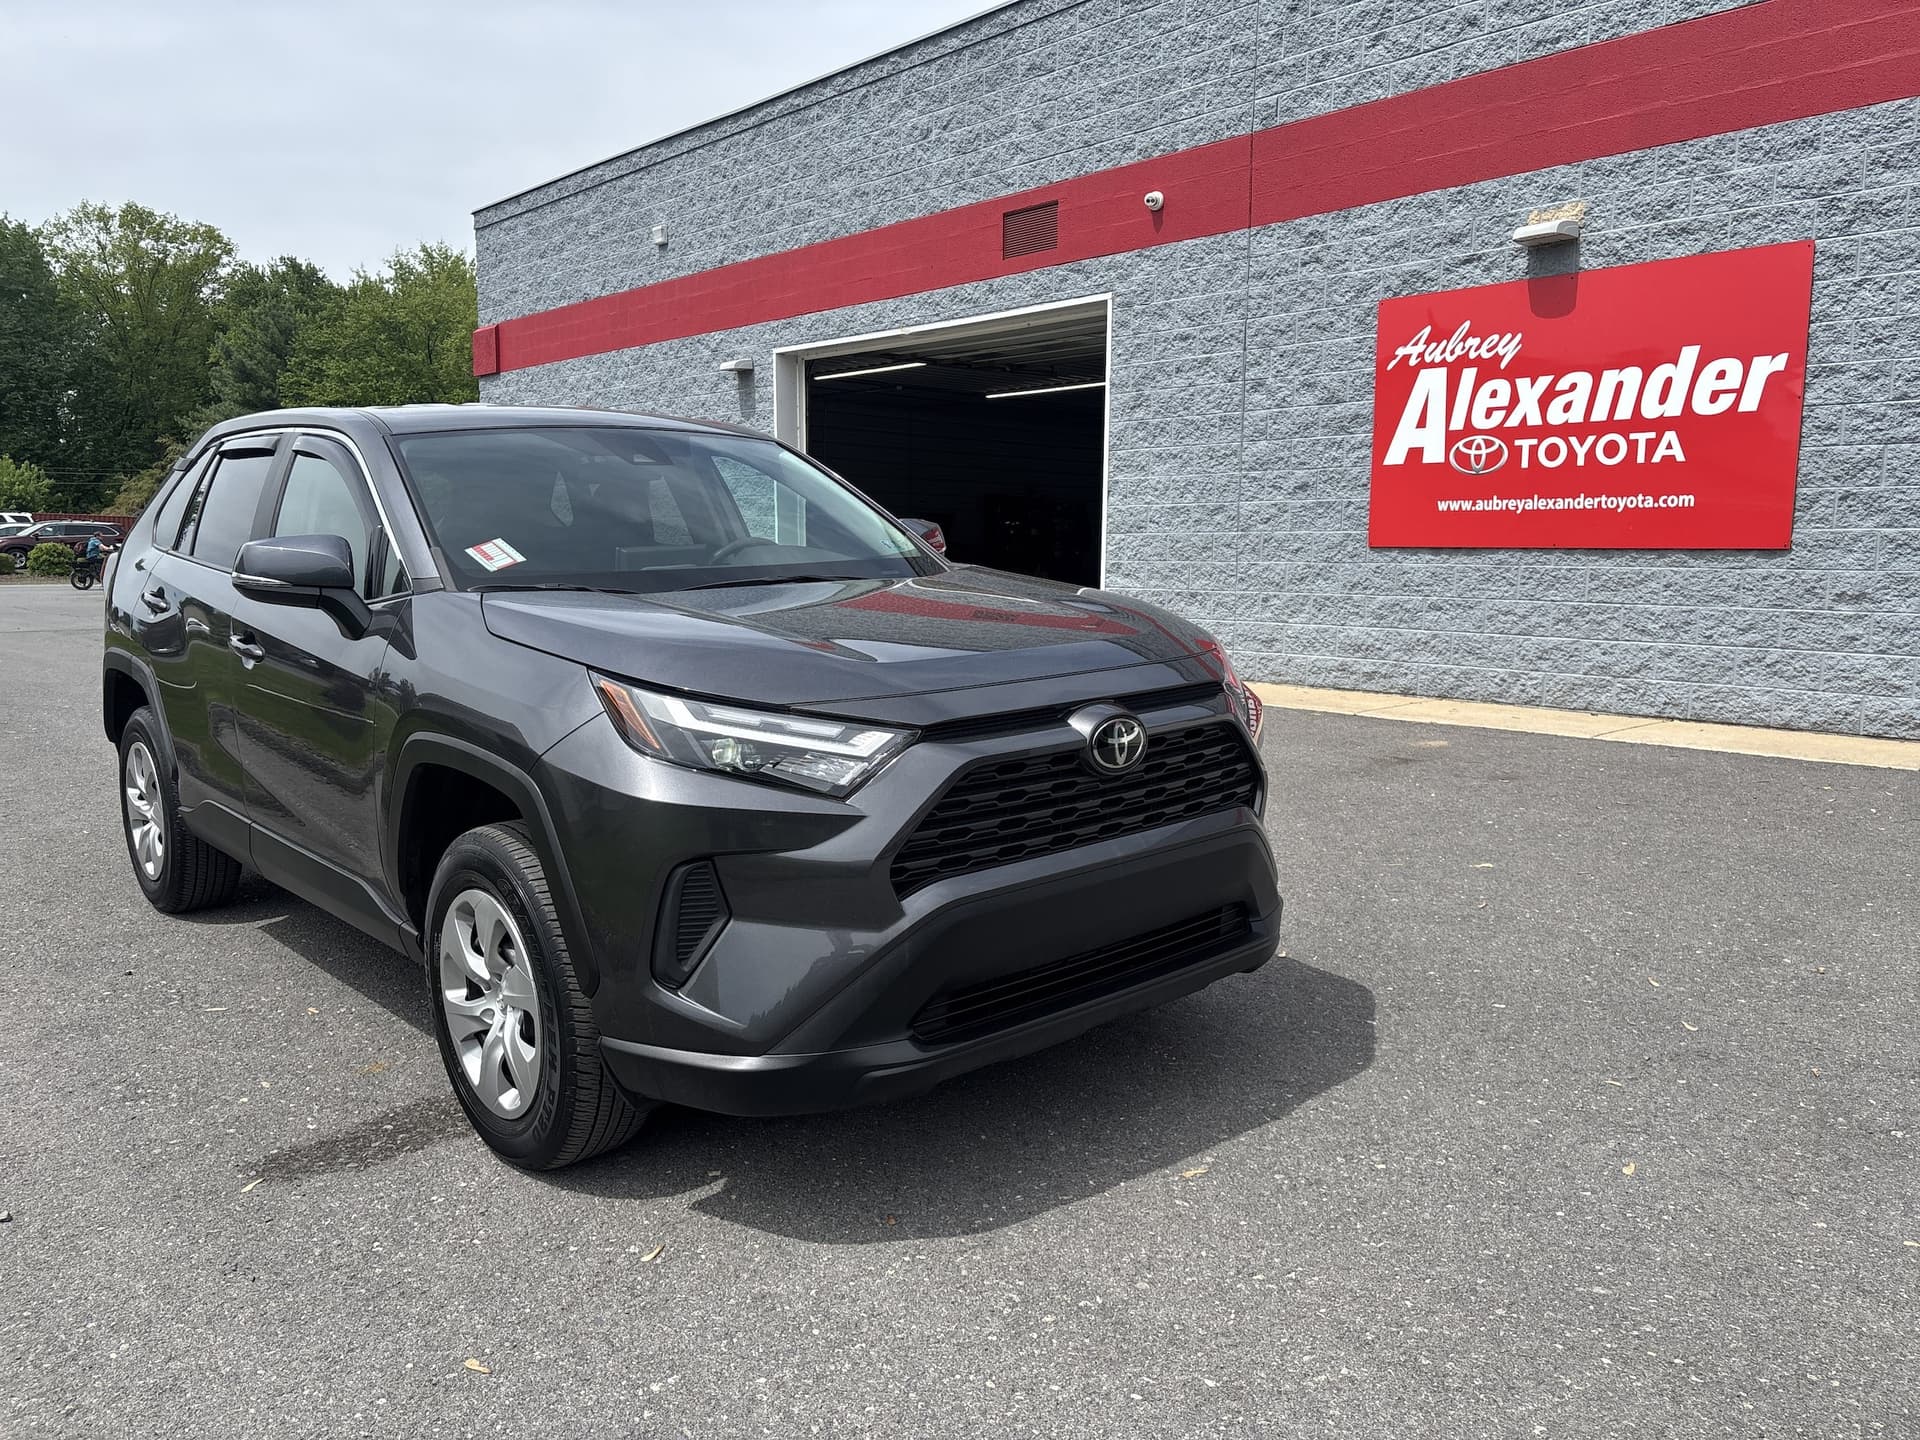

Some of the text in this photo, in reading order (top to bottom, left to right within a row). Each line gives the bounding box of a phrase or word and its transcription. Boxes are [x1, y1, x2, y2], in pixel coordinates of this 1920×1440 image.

[1387, 320, 1523, 371] Aubrey
[1383, 345, 1790, 466] Alexander
[1513, 430, 1686, 469] TOYOTA
[1437, 494, 1695, 514] www.aubreyalexandertoyota.com
